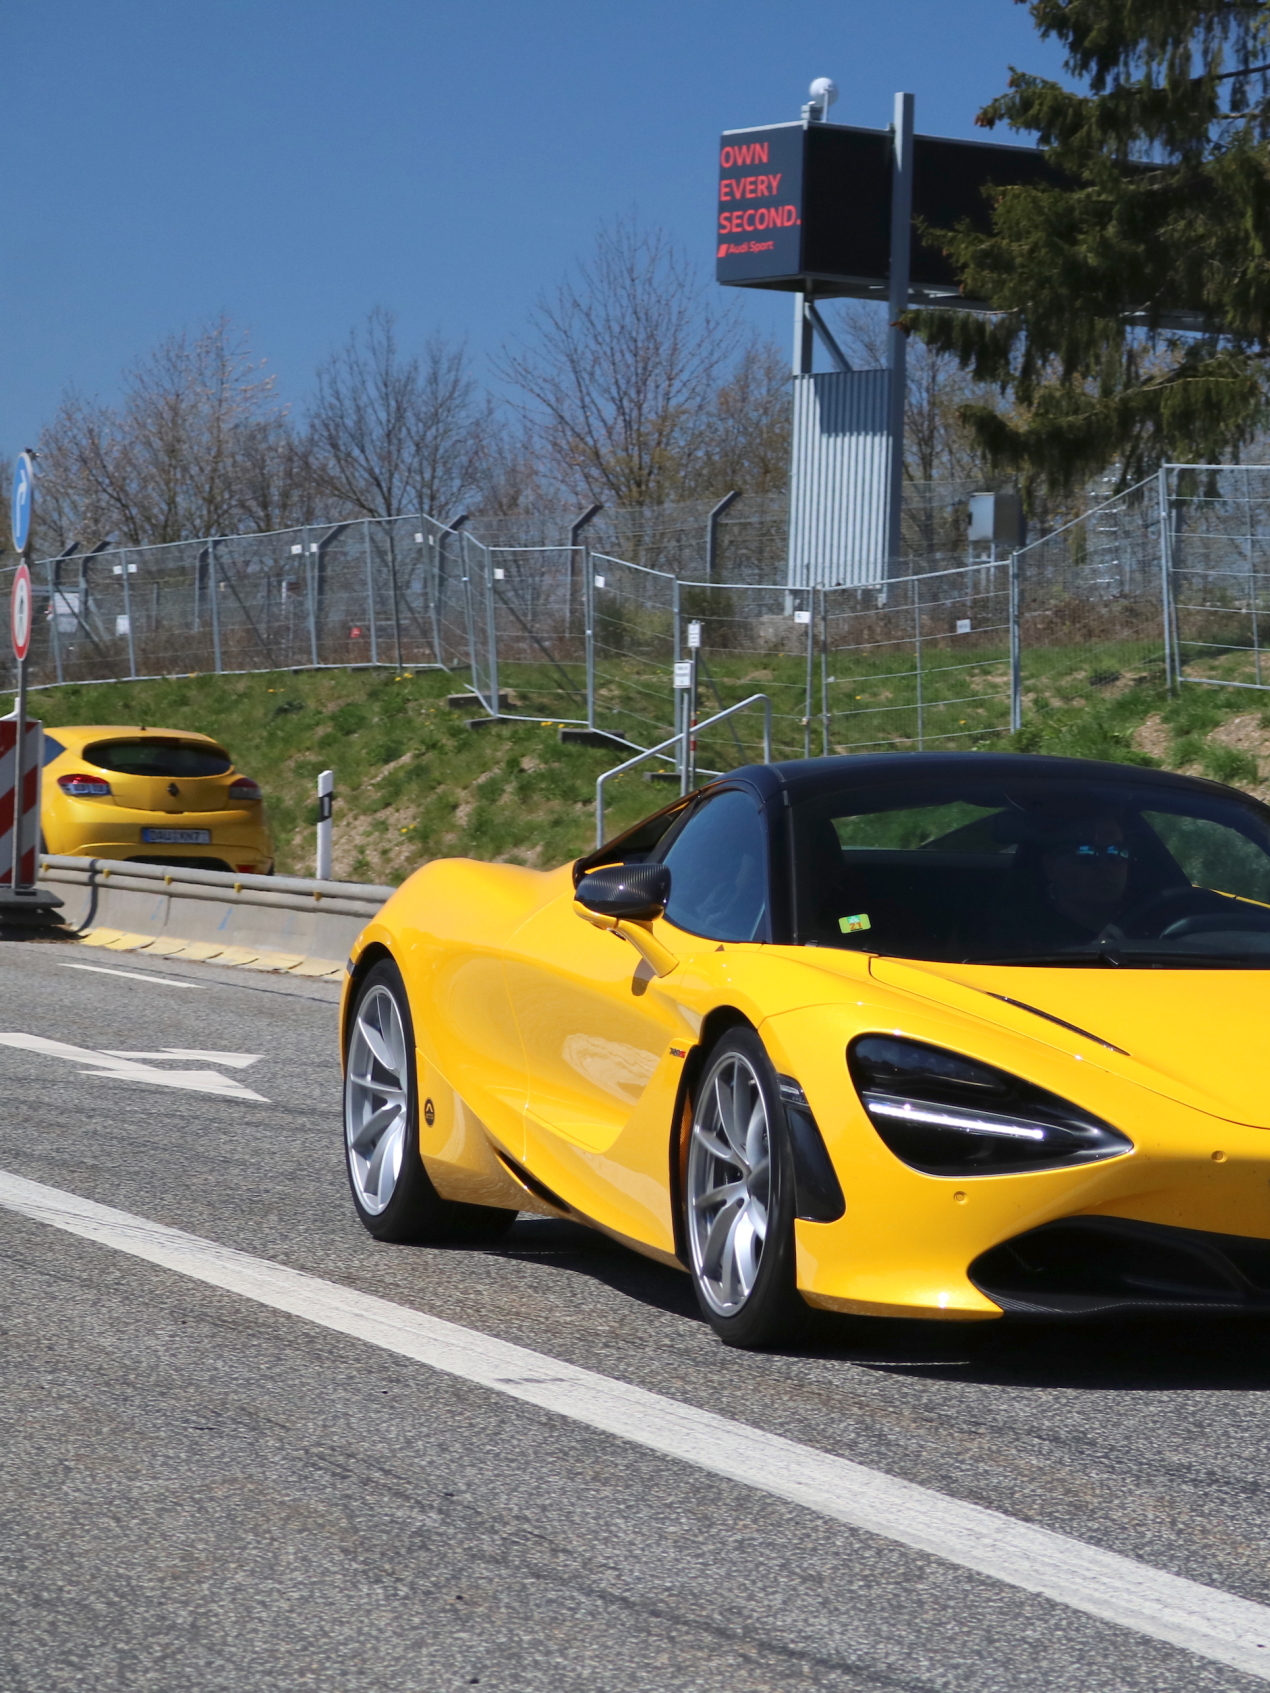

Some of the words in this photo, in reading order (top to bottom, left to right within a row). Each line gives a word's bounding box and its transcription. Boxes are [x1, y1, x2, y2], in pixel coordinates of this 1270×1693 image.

[720, 142, 768, 168] OWN
[720, 173, 781, 201] EVERY
[719, 205, 802, 234] SECOND.
[728, 243, 749, 254] Audi
[750, 241, 774, 253] Sport
